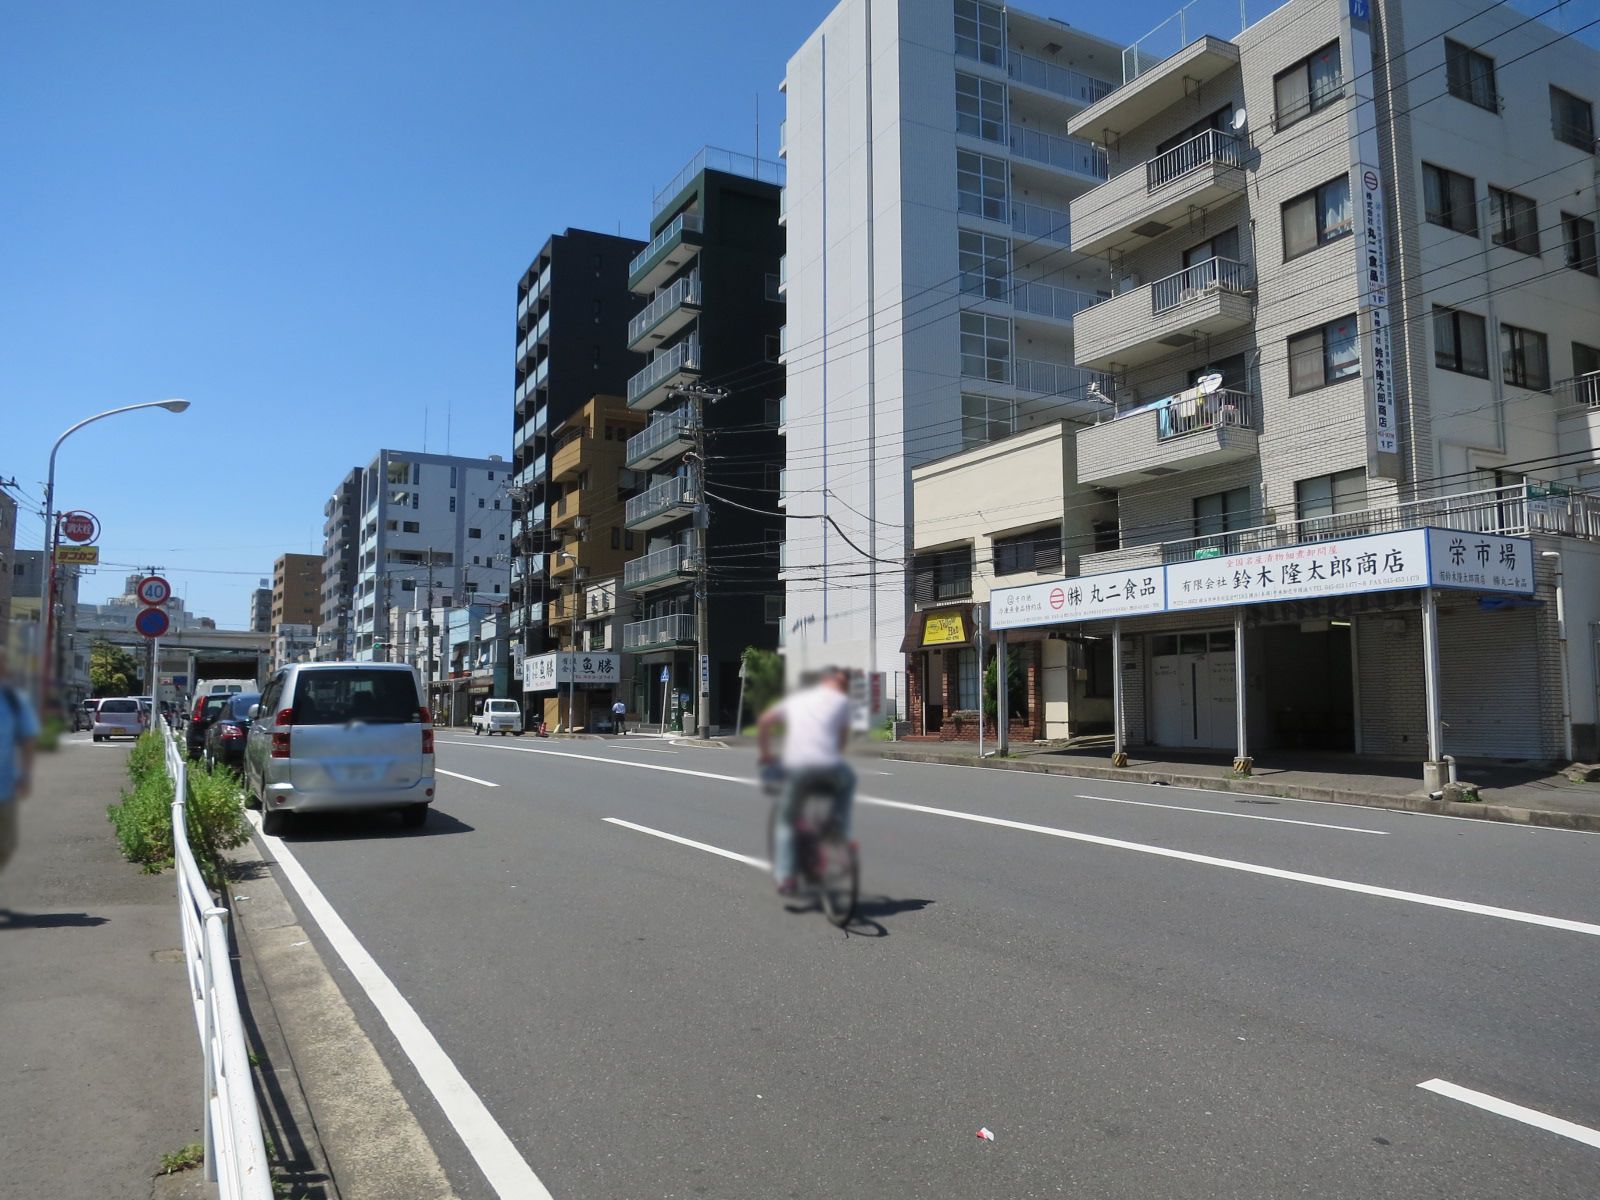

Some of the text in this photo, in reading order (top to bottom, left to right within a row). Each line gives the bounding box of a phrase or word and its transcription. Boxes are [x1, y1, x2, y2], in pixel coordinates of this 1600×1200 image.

[1380, 440, 1393, 449] 1F
[1448, 538, 1517, 571] 栄市場
[144, 585, 164, 599] 40
[580, 657, 615, 673] 魚勝
